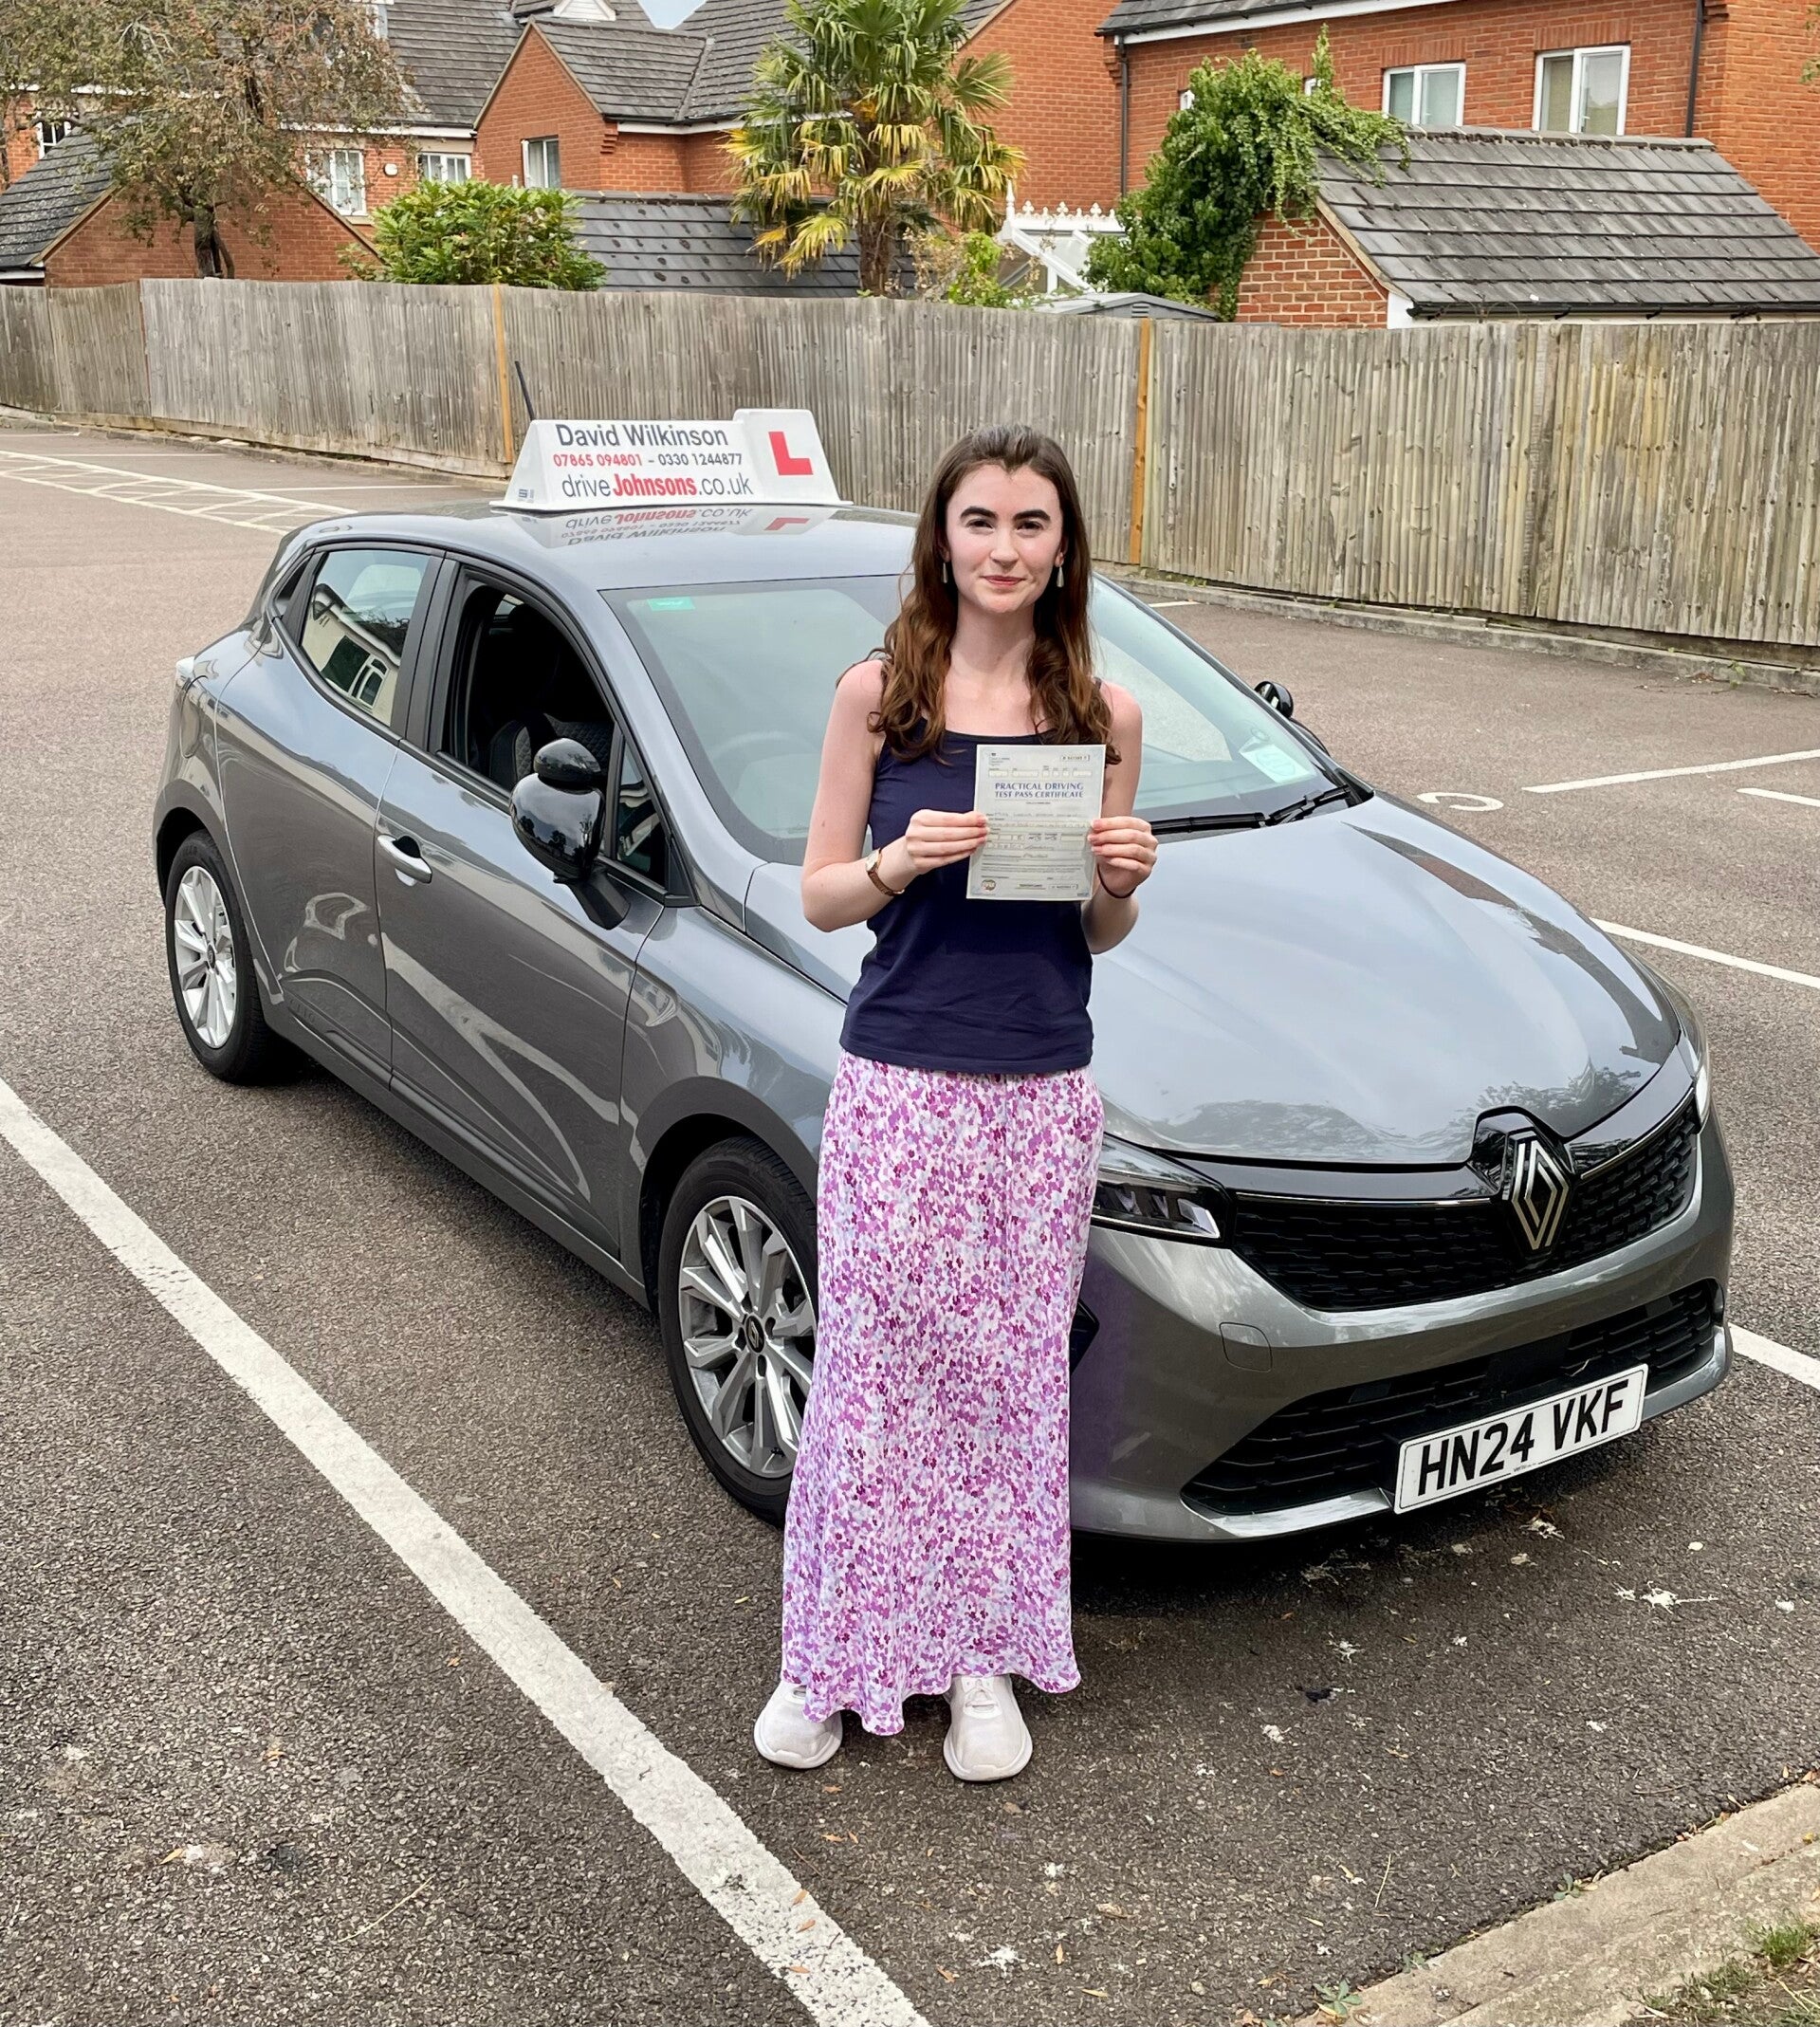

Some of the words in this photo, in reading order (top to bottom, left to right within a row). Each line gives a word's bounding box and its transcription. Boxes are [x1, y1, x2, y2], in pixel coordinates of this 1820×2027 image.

[555, 423, 620, 447] David
[621, 423, 729, 446] Wilkinson
[553, 453, 594, 468] 07865
[596, 453, 643, 467] 094801
[657, 452, 689, 466] 0330
[692, 452, 743, 466] 1244877
[767, 431, 814, 475] L
[561, 472, 755, 498] driveJohnsons.co.uk
[1417, 1411, 1535, 1497] HN24
[1553, 1379, 1629, 1451] VKF
